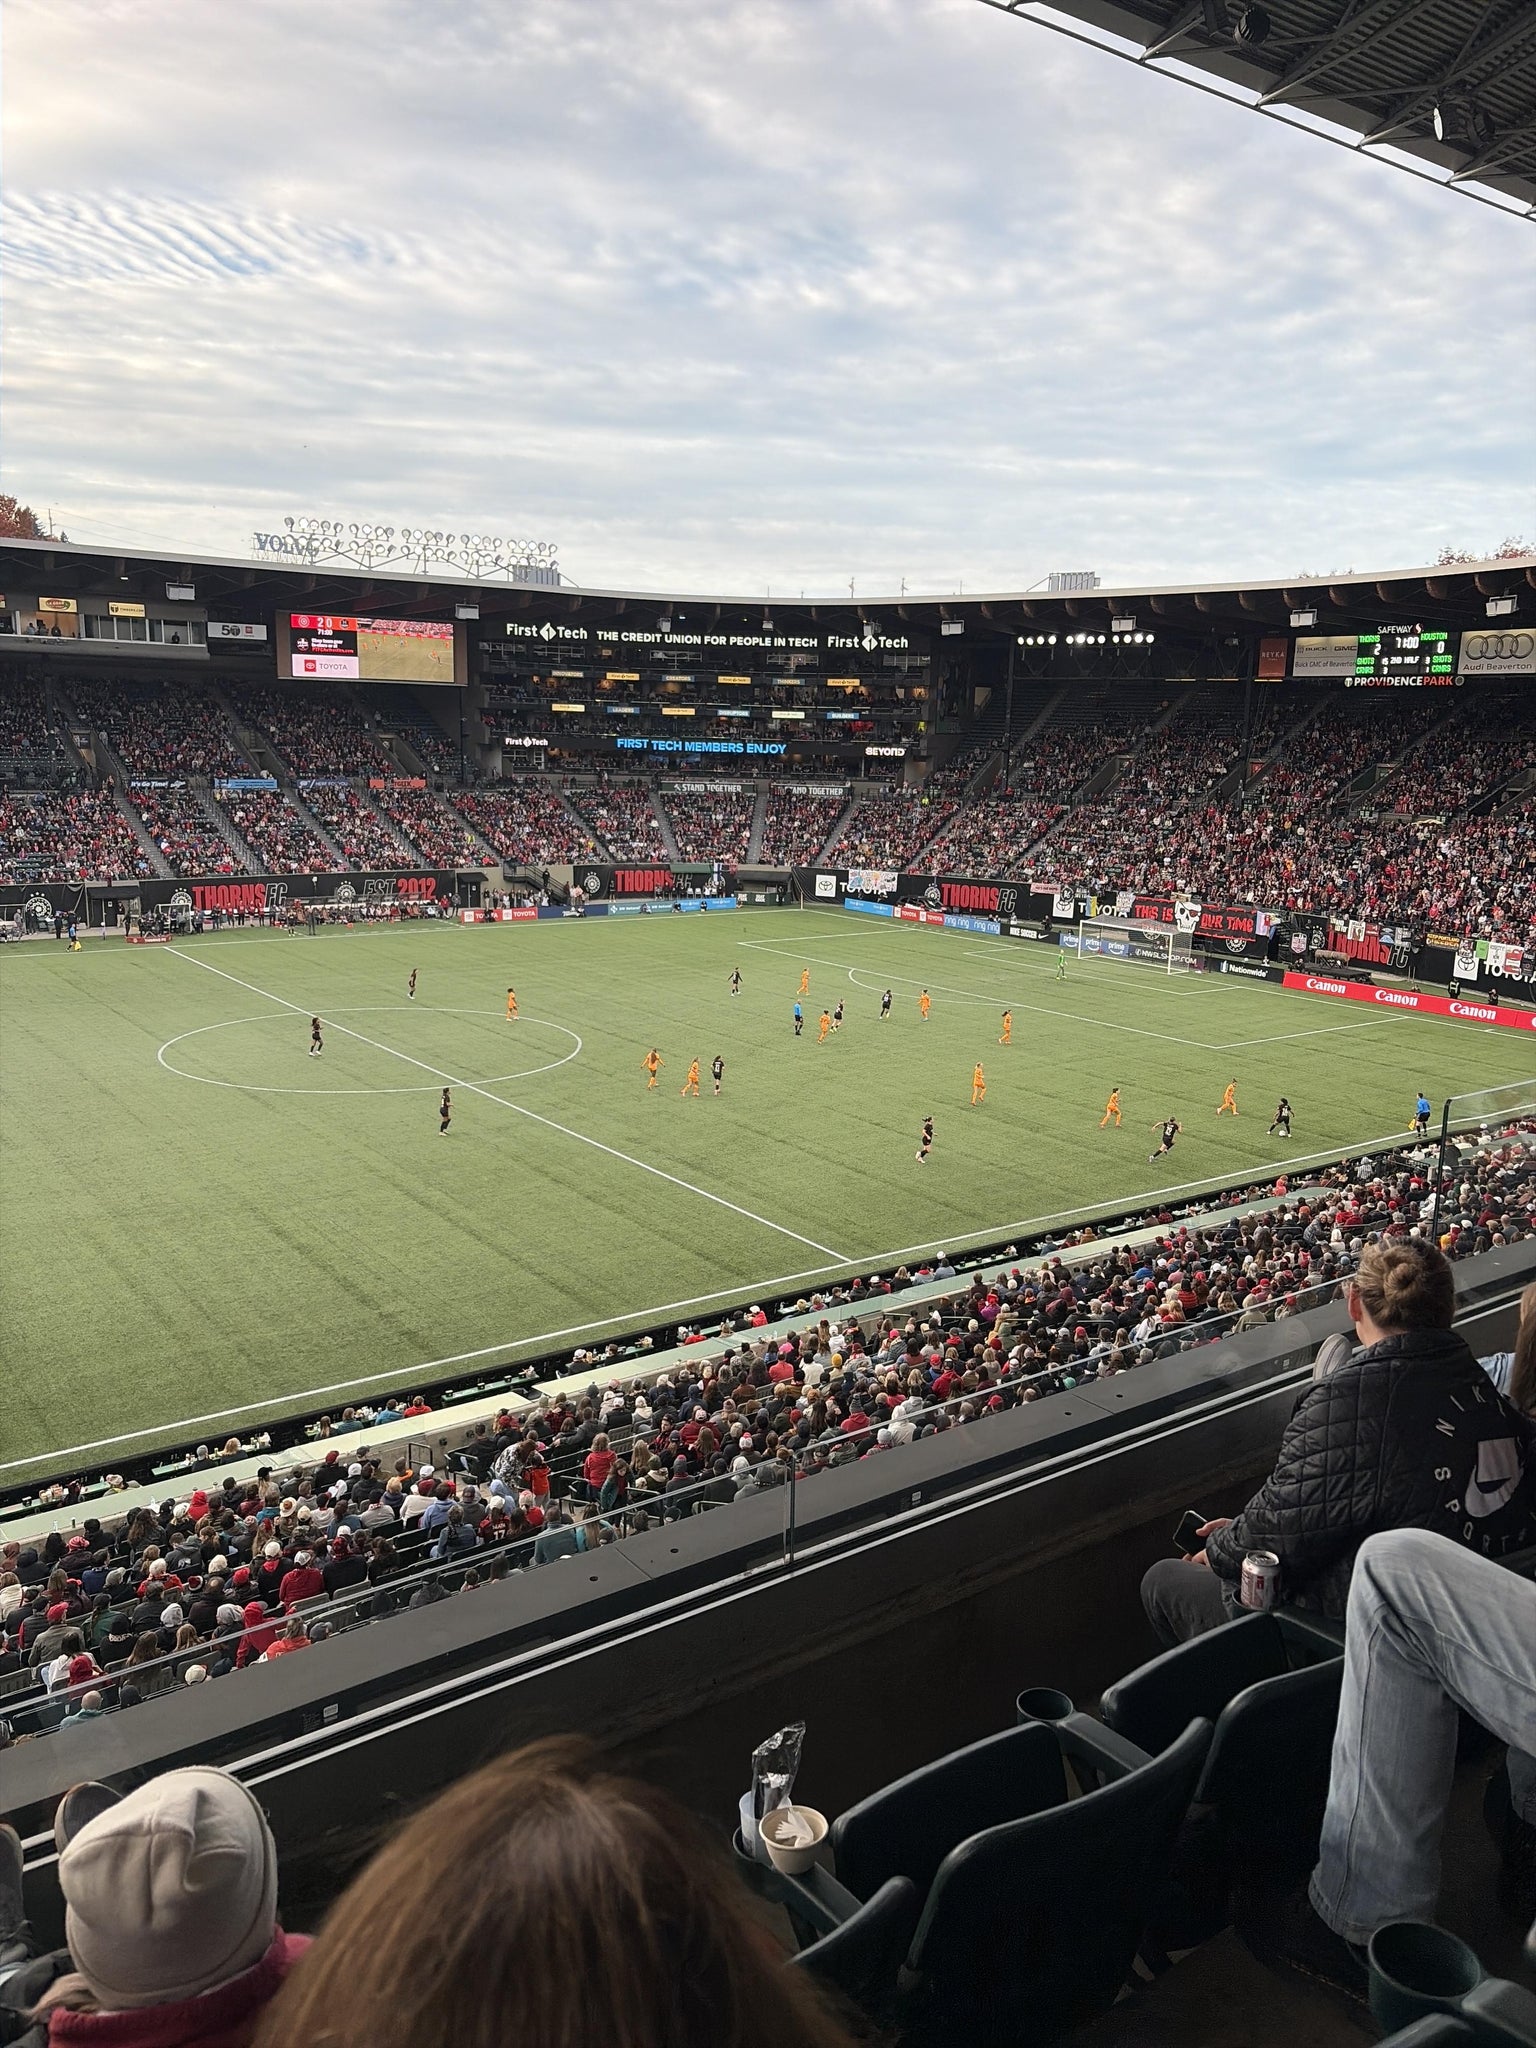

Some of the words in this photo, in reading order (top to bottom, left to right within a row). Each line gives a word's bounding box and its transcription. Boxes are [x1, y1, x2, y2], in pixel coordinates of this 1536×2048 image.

[317, 617, 324, 628] 2
[325, 618, 333, 628] 0
[506, 623, 538, 637] First
[557, 626, 588, 640] Tech
[1377, 625, 1413, 634] SAFEWAY
[597, 630, 619, 641] THE
[621, 631, 662, 643] CREDIT
[664, 634, 702, 645] UNION
[704, 635, 727, 646] FOR
[729, 636, 772, 647] PEOPLE
[774, 637, 786, 647] IN
[788, 637, 818, 648] TECH
[1420, 632, 1448, 641] HOUSTON
[827, 636, 859, 649] First
[878, 636, 909, 649] Tech
[1437, 641, 1445, 654] 0
[1373, 643, 1382, 656] 2
[1463, 663, 1484, 671] Audi
[1486, 663, 1532, 671] Beaverton
[505, 737, 522, 746] First
[532, 738, 548, 746] Tech
[617, 738, 649, 749] FIRST
[651, 740, 682, 751] TECH
[684, 741, 744, 753] MEMBERS
[746, 743, 787, 754] ENJOY
[682, 784, 705, 792] STAND
[706, 784, 742, 793] TOGETHER
[808, 787, 844, 796] TOGETHER
[513, 910, 536, 918] TOYOTA
[901, 911, 917, 919] TOYOTA
[1078, 902, 1128, 918] TYOTA
[927, 914, 943, 923] TOYOTA
[945, 916, 956, 927] ring
[957, 918, 970, 930] ring
[974, 920, 986, 931] ring
[987, 922, 1000, 932] ring
[1063, 935, 1079, 943] prime
[1085, 937, 1101, 945] prime
[1108, 941, 1125, 950] prime
[1229, 964, 1267, 978] Nationwide
[1306, 978, 1347, 995] Canon
[1375, 989, 1418, 1007] Canon
[1449, 1002, 1497, 1020] Canon
[493, 1530, 506, 1541] 17
